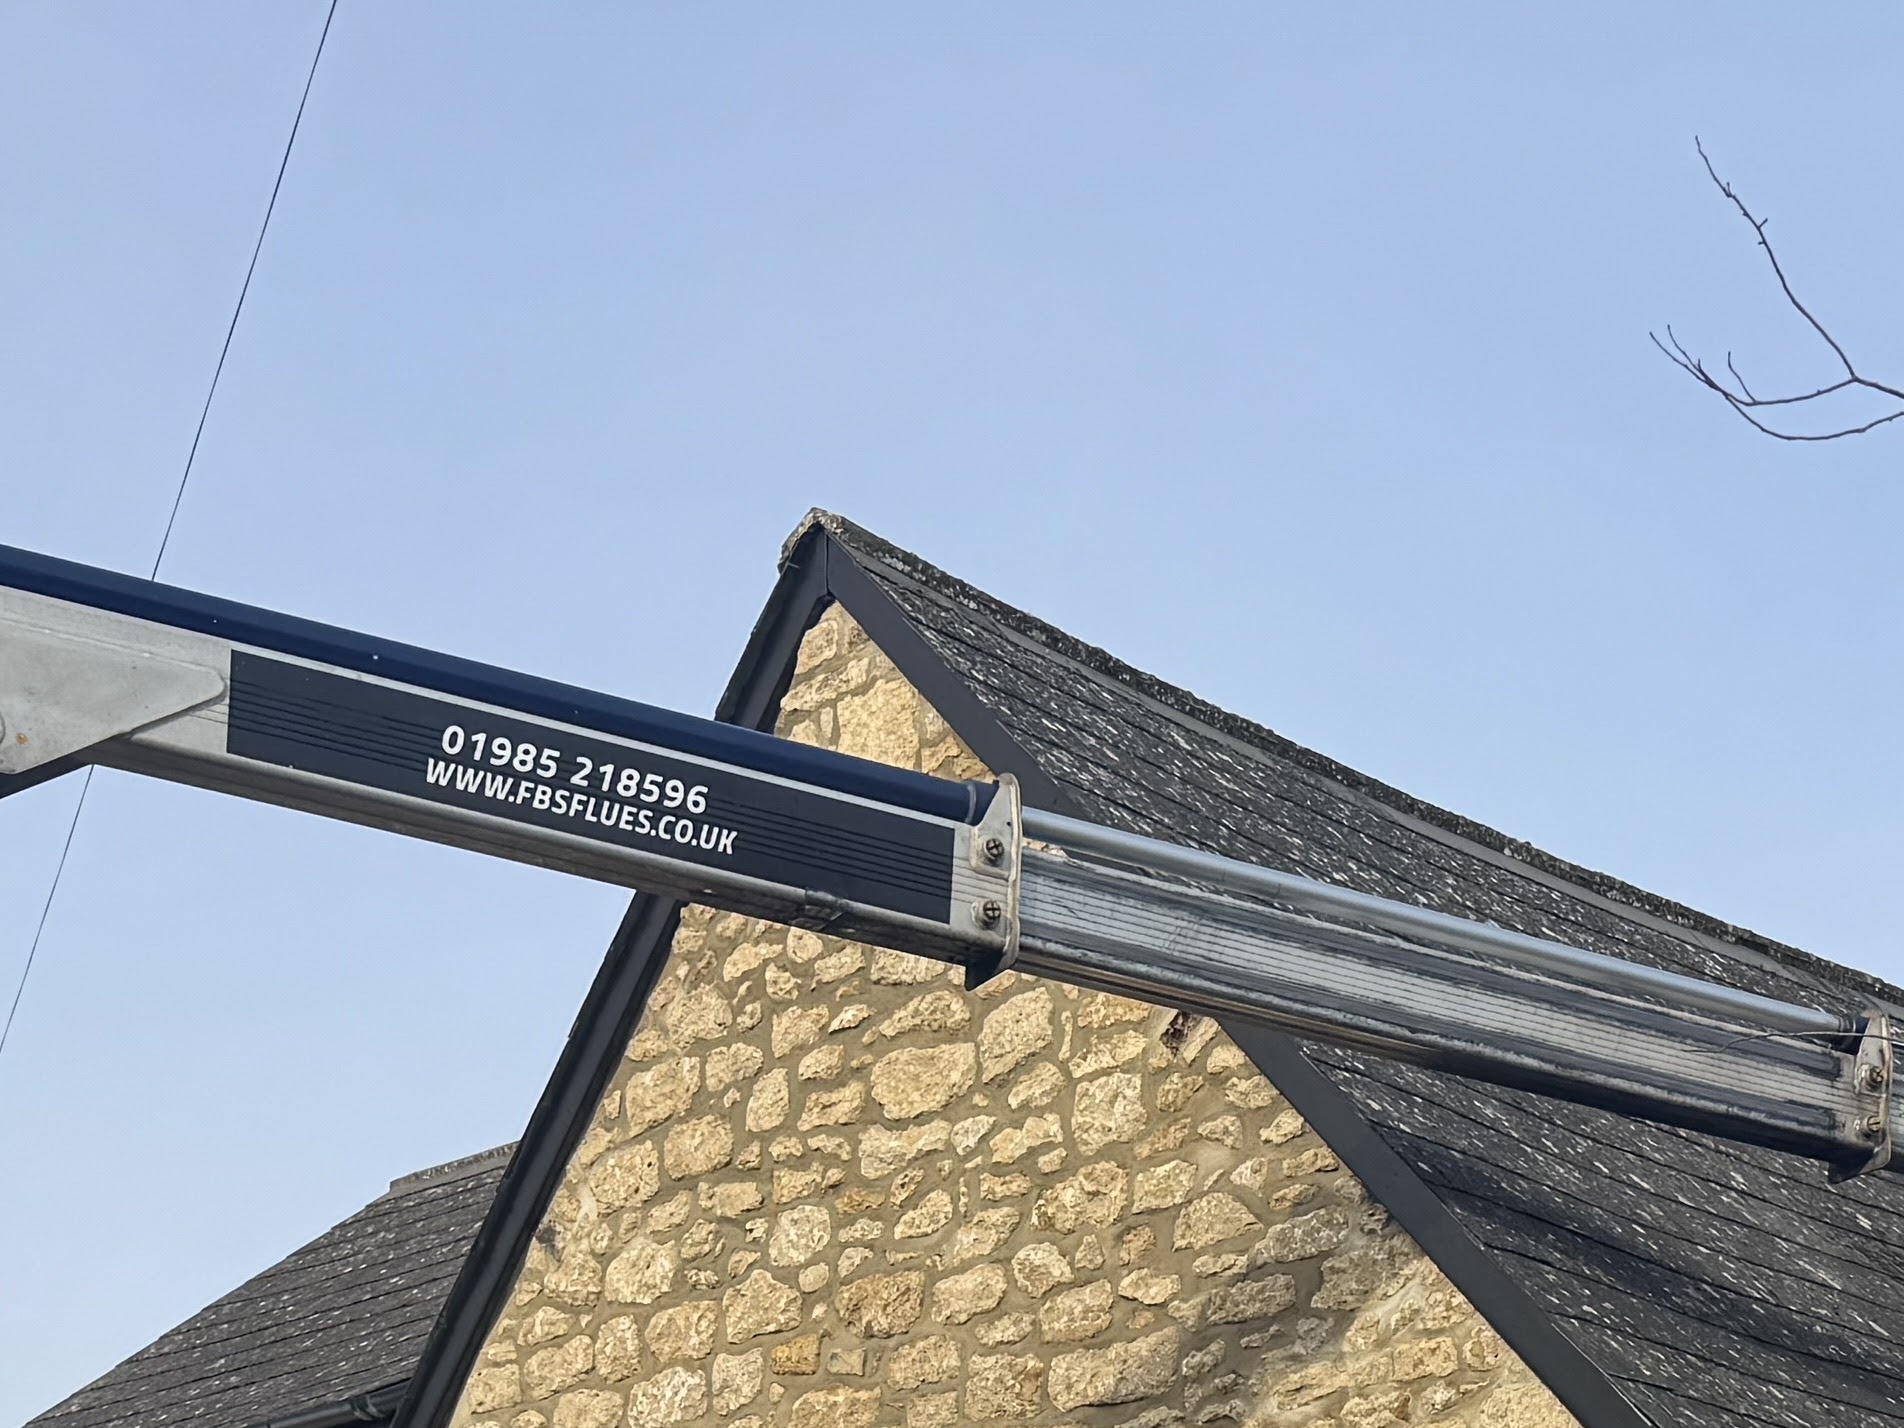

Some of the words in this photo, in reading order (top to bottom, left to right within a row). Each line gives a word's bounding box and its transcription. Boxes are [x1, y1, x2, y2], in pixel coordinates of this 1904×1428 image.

[426, 757, 739, 855] WWW.FBSFLUES.CO.UK
[441, 724, 559, 779] 01985
[569, 756, 708, 814] 218596
